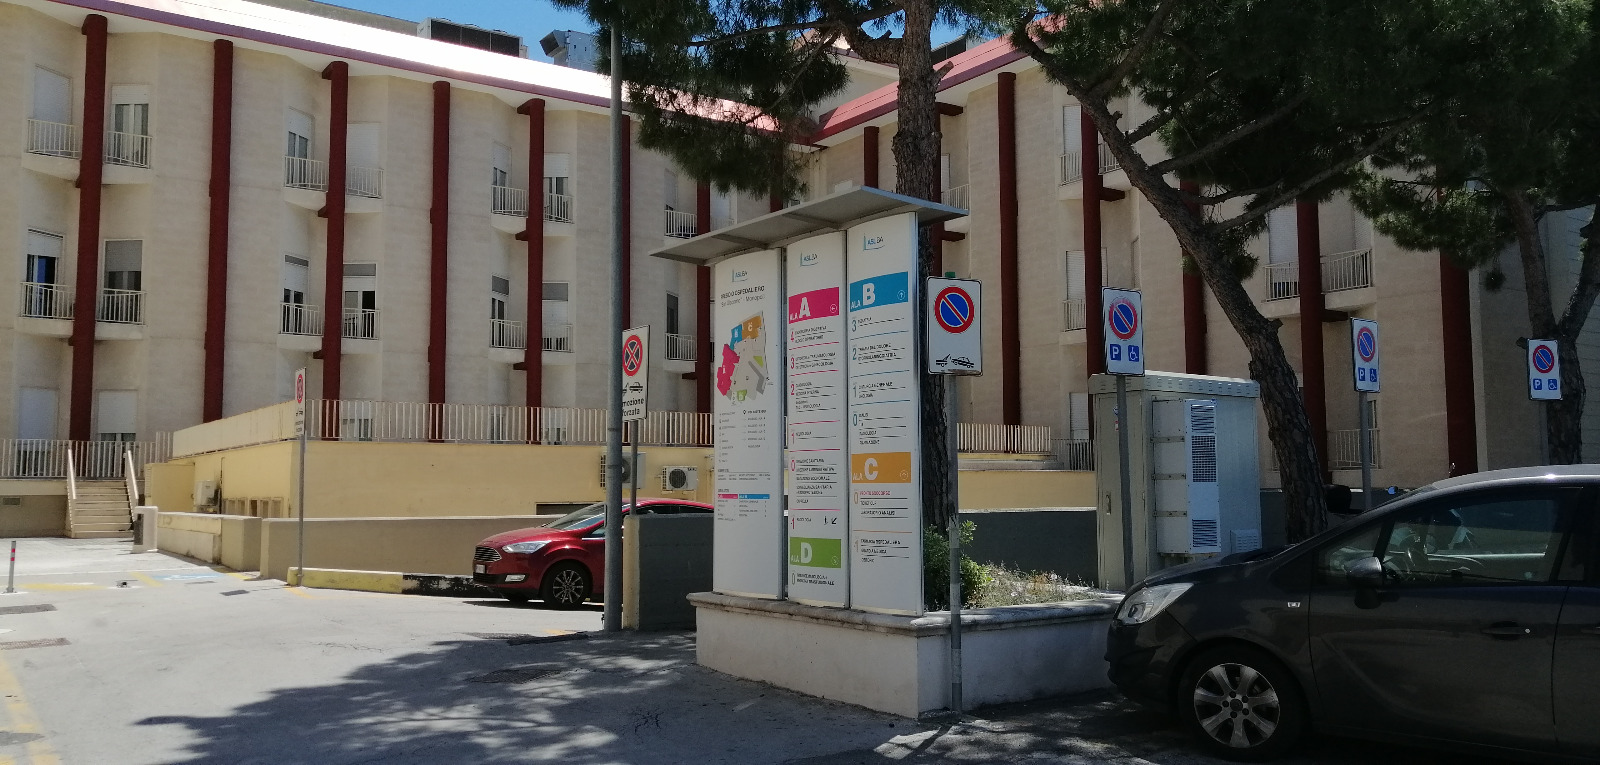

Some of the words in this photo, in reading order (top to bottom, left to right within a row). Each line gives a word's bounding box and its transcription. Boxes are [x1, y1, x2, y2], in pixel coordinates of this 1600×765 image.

[851, 300, 861, 309] ALA
[863, 283, 875, 306] B
[799, 297, 811, 318] A
[852, 320, 857, 332] 3
[853, 347, 857, 360] 2
[1112, 346, 1119, 359] P
[790, 357, 795, 369] 3
[790, 384, 795, 395] 2
[1535, 379, 1541, 389] P
[853, 385, 857, 398] 1
[622, 398, 644, 407] mozione
[853, 413, 858, 426] 0
[791, 459, 795, 471] 0
[853, 472, 863, 480] ALA
[864, 457, 879, 481] C
[853, 492, 858, 504] 0
[801, 542, 812, 563] D
